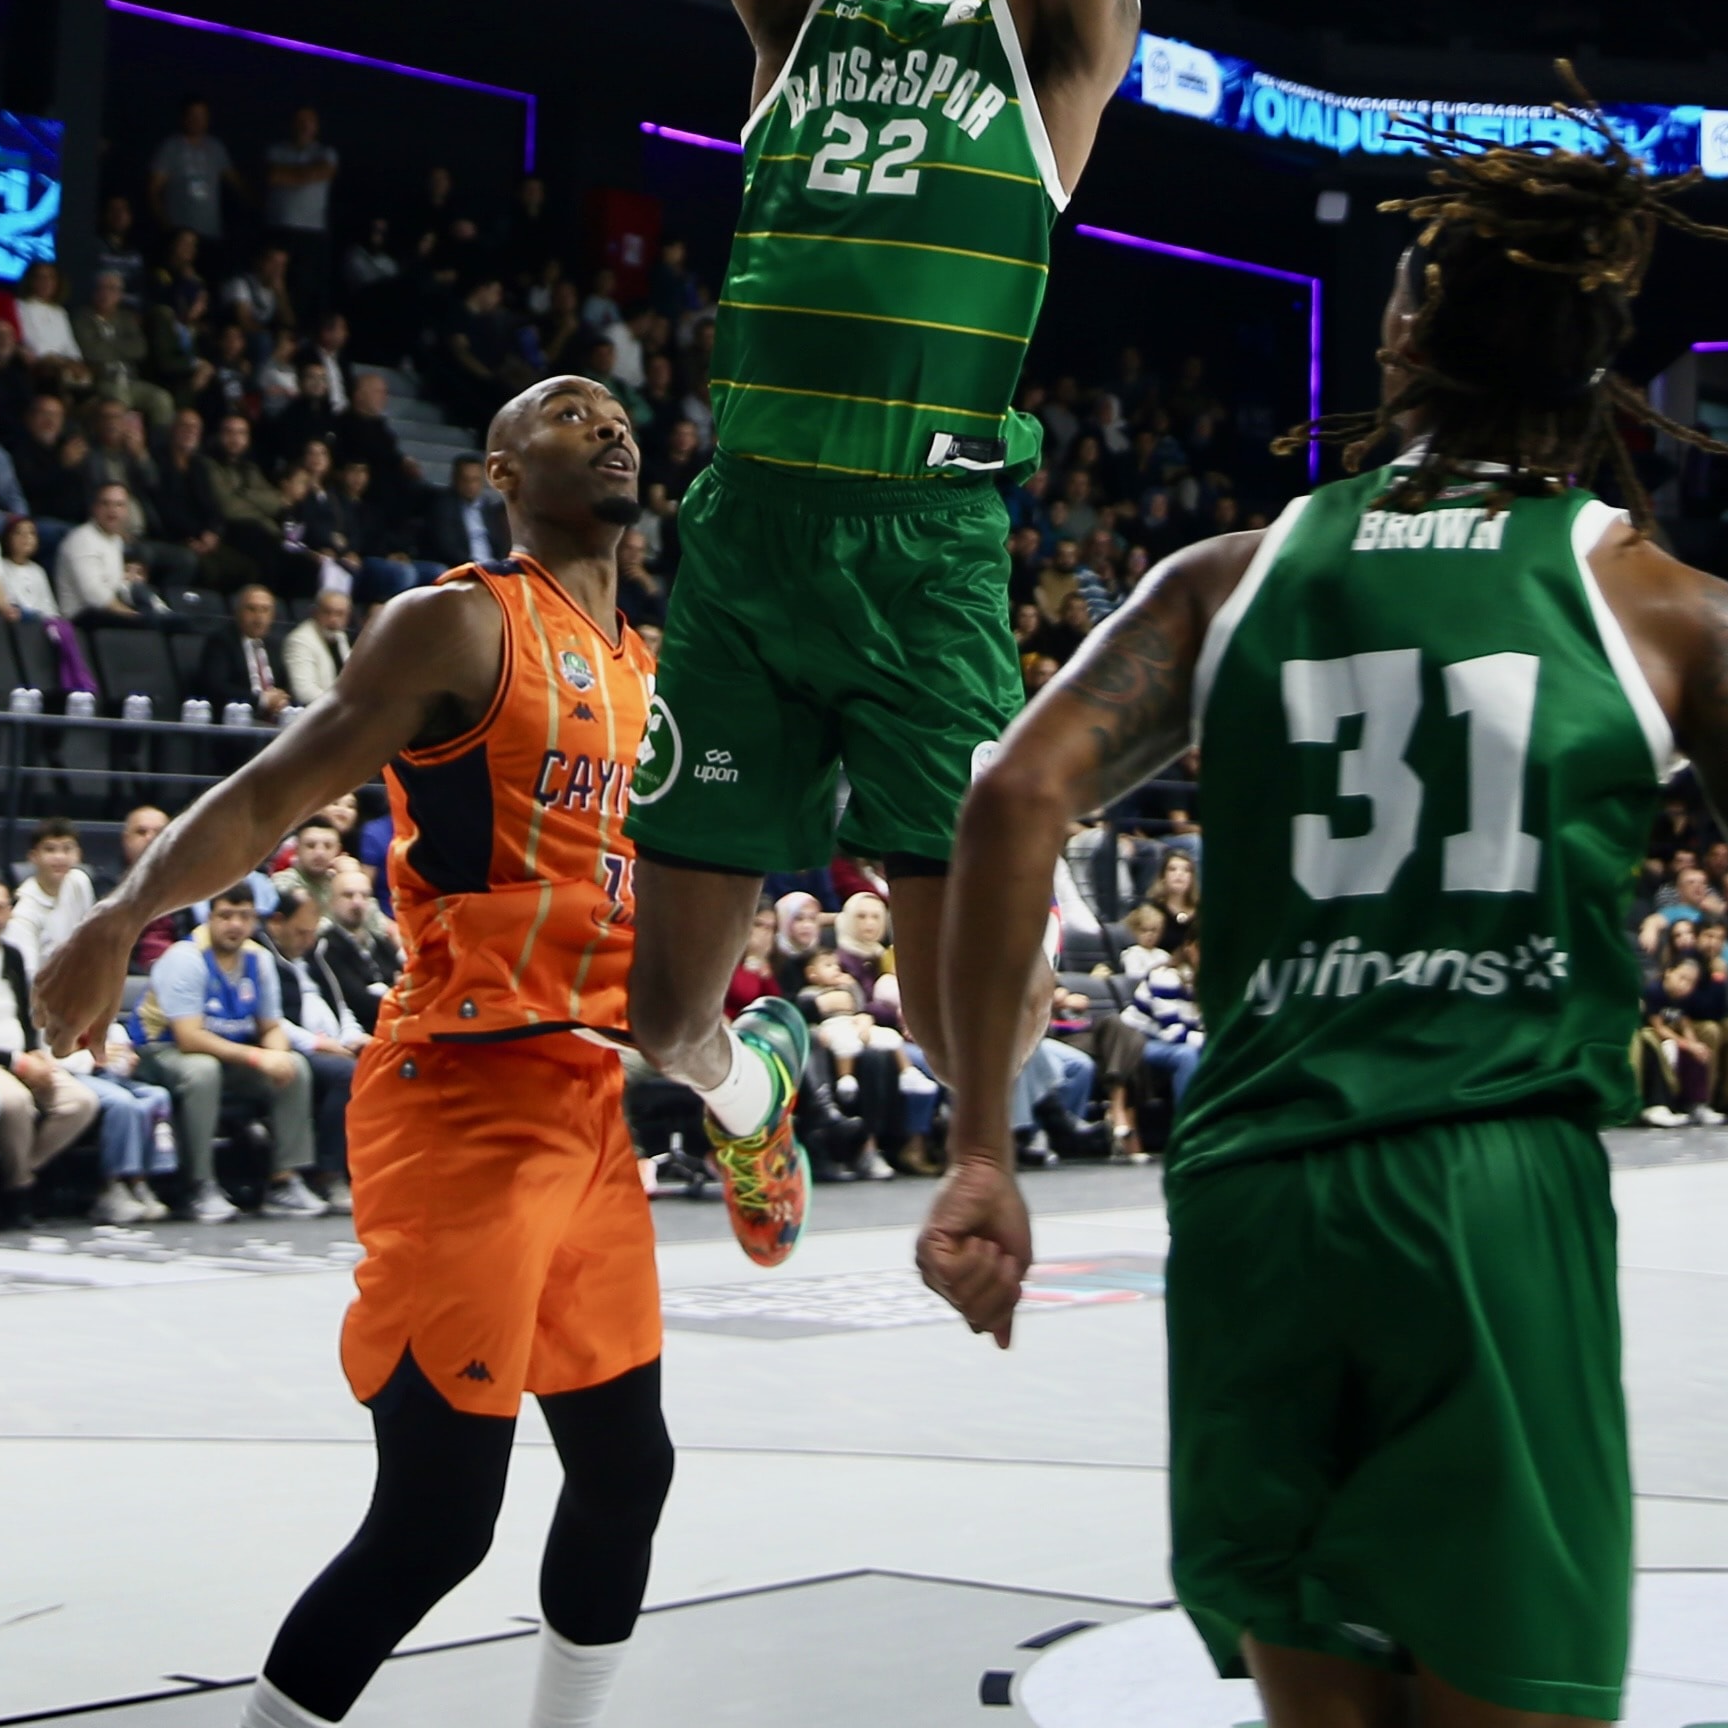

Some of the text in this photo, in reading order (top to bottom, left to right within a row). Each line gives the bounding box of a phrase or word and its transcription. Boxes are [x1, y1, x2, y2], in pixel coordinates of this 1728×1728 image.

[806, 111, 928, 195] 22
[1353, 507, 1510, 551] BROWN
[694, 763, 738, 783] upon
[1281, 647, 1542, 900] 31
